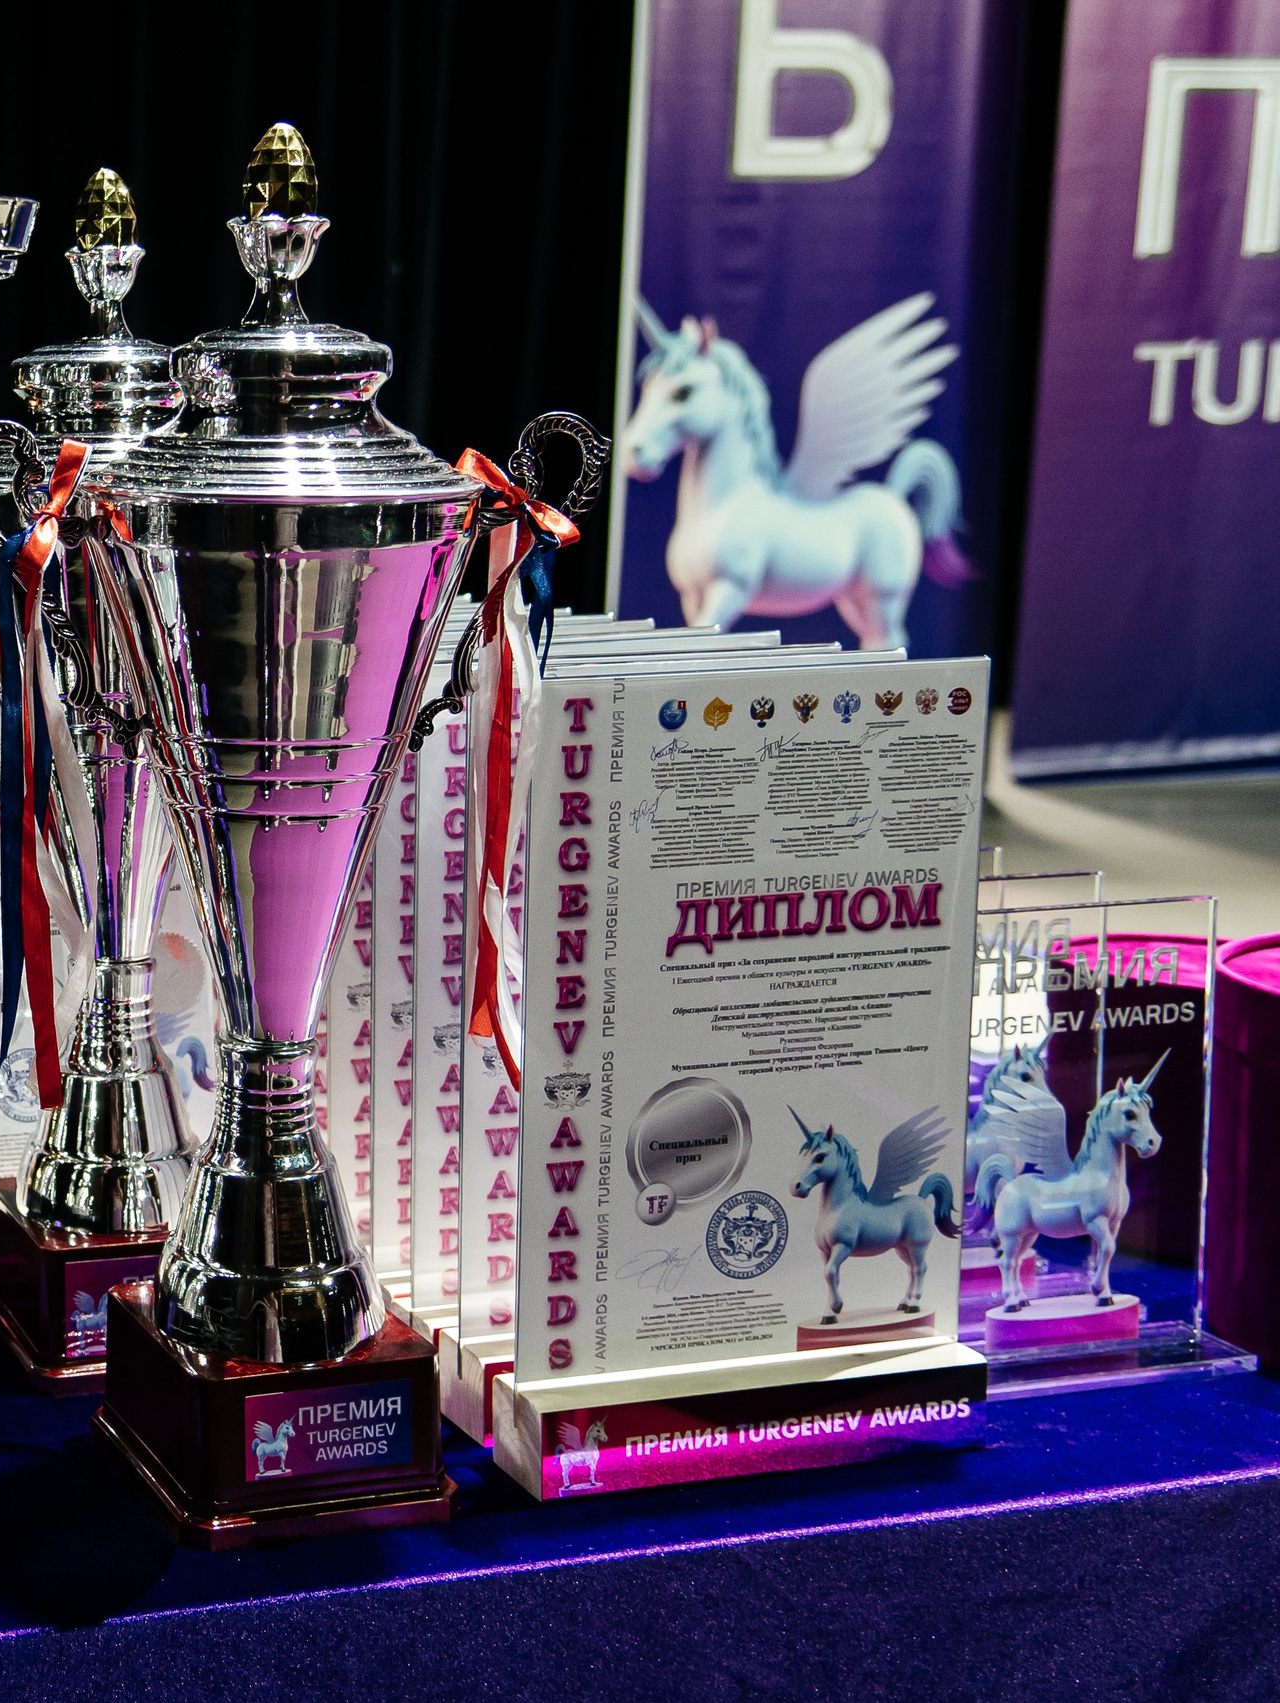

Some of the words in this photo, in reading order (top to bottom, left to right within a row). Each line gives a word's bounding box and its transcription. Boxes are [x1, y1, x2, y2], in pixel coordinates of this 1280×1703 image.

[610, 710, 624, 782] ПРЕМИЯ
[608, 800, 622, 869] AWARDS
[440, 700, 466, 1005] URGENEV
[552, 697, 594, 1056] TURGENEV
[677, 880, 756, 899] ПРЕМИЯ
[764, 873, 858, 892] TURGENEV
[863, 867, 939, 886] AWARDS
[605, 875, 619, 960] TURGENEV
[665, 883, 941, 957] ДИПЛОМ
[660, 961, 716, 972] Специальный
[717, 960, 736, 969] приз
[753, 955, 797, 965] сохранение
[798, 953, 834, 963] народной
[836, 947, 908, 959] инструментальной
[677, 975, 714, 984] Ежегодной
[715, 974, 741, 982] премии
[747, 971, 774, 979] области
[776, 969, 806, 978] культуры
[814, 966, 846, 974] искусства
[847, 961, 894, 971] «TURGENEV
[896, 959, 932, 968] AWARDS»
[972, 947, 1179, 997] ПРЕМИЯ
[769, 978, 837, 990] НАГРАЖДАЕТСЯ
[602, 967, 616, 1037] ПРЕМИЯ
[672, 1004, 719, 1016] Образцовый
[720, 1003, 760, 1011] коллектив
[761, 997, 819, 1008] любительского
[820, 993, 886, 1004] художественного
[711, 1012, 745, 1023] Детский
[747, 1007, 822, 1020] инструментальный
[824, 1004, 859, 1013] ансамбль
[1091, 1002, 1195, 1030] AWARDS
[712, 1021, 774, 1031] Инструментальное
[815, 1015, 848, 1024] Народные
[849, 1012, 892, 1021] инструменты
[741, 1030, 786, 1039] Музыкальная
[787, 1027, 826, 1035] композиция
[779, 1036, 824, 1045] Руководитель
[782, 1045, 816, 1053] Екатерина
[671, 1061, 729, 1072] Муниципальное
[730, 1058, 771, 1066] автономное
[772, 1055, 813, 1065] учреждение
[814, 1052, 848, 1061] культуры
[850, 1050, 872, 1058] города
[874, 1047, 902, 1055] Тюмени
[738, 1066, 774, 1075] татарской
[775, 1063, 813, 1073] культуры»
[814, 1062, 835, 1070] Город
[600, 1050, 614, 1118] AWARDS
[649, 1135, 729, 1152] Специальный
[597, 1124, 612, 1207] TURGENEV
[675, 1153, 702, 1166] приз
[484, 1084, 519, 1326] AWARDS
[546, 1116, 586, 1370] AWARDS
[596, 1213, 610, 1282] ПРЕМИЯ
[595, 1293, 608, 1360] AWARDS
[298, 1396, 402, 1426] ПРЕМИЯ
[306, 1422, 397, 1445] TURGENEV
[625, 1426, 728, 1458] ПРЕМИЯ
[737, 1408, 863, 1445] TURGENEV
[869, 1398, 971, 1429] AWARDS
[315, 1440, 388, 1462] AWARDS
